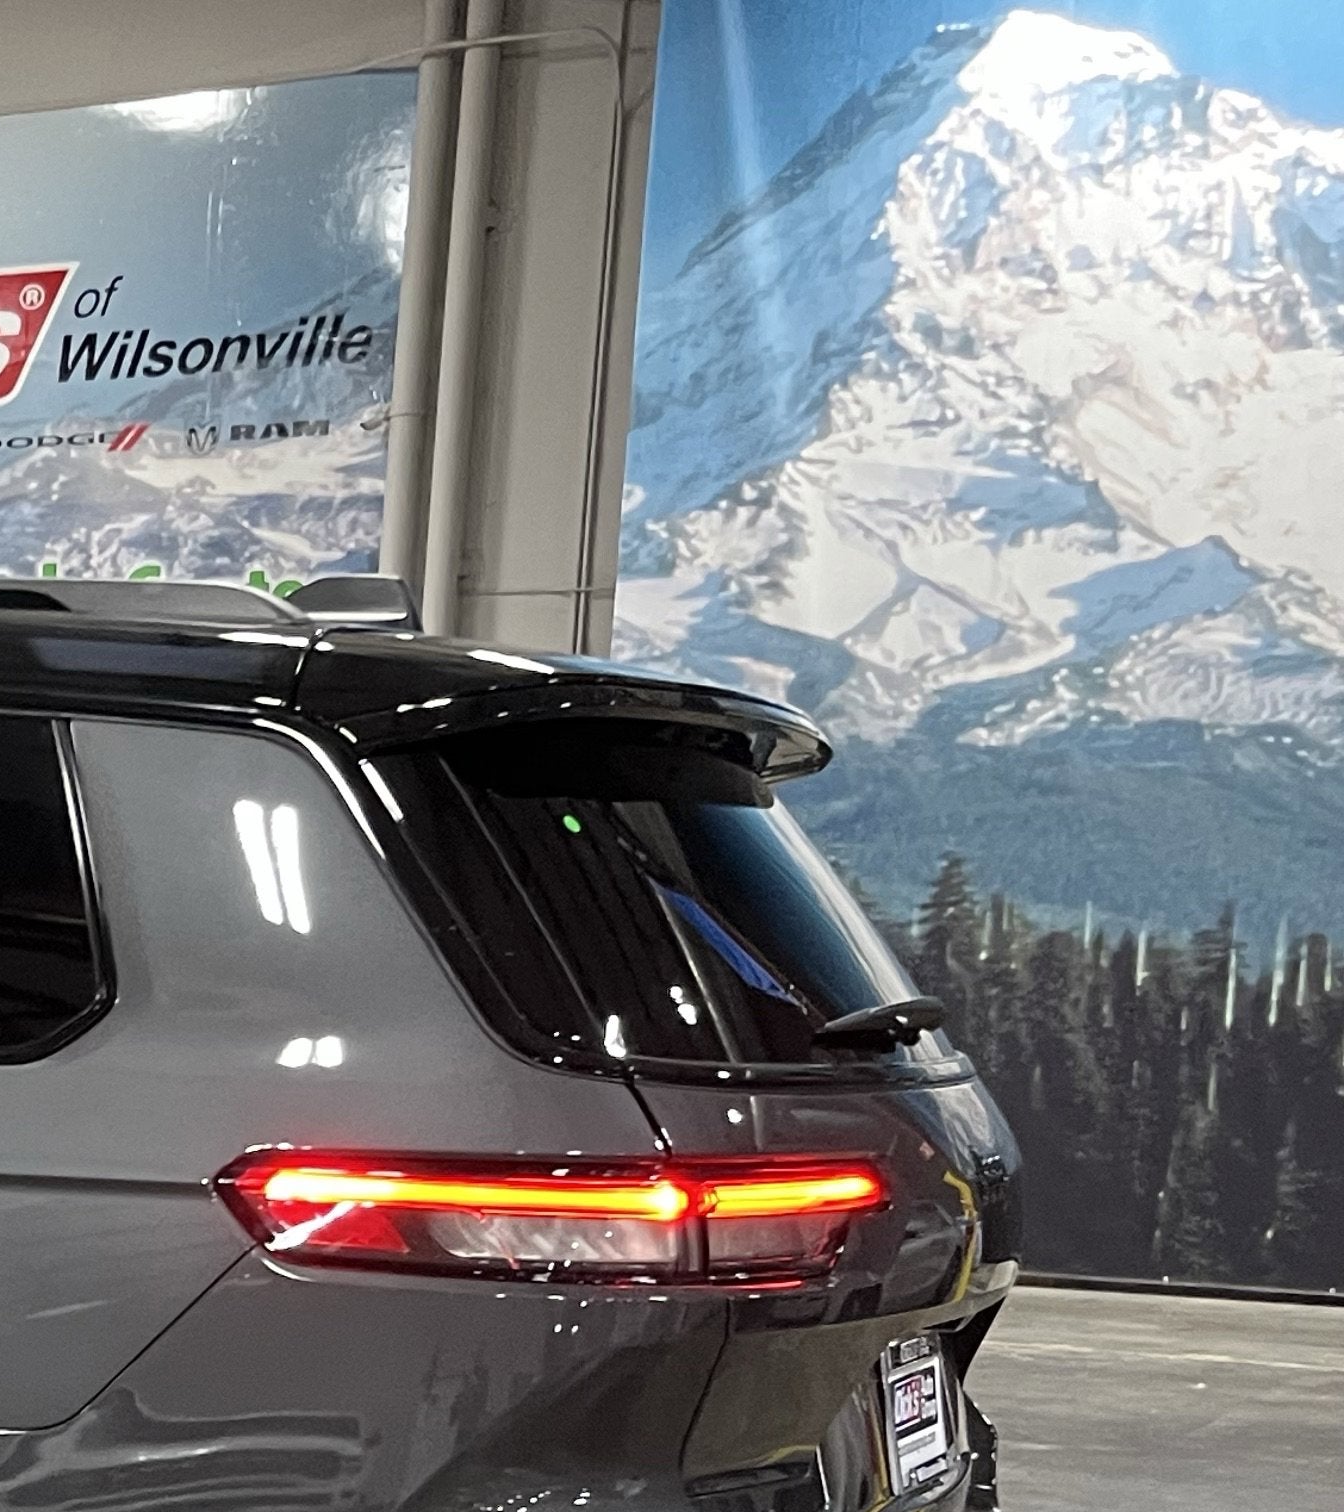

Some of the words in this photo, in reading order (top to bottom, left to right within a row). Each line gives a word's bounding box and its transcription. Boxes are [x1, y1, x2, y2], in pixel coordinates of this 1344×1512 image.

[73, 275, 124, 319] of
[58, 311, 374, 383] Wilsonville
[230, 419, 331, 442] RAM
